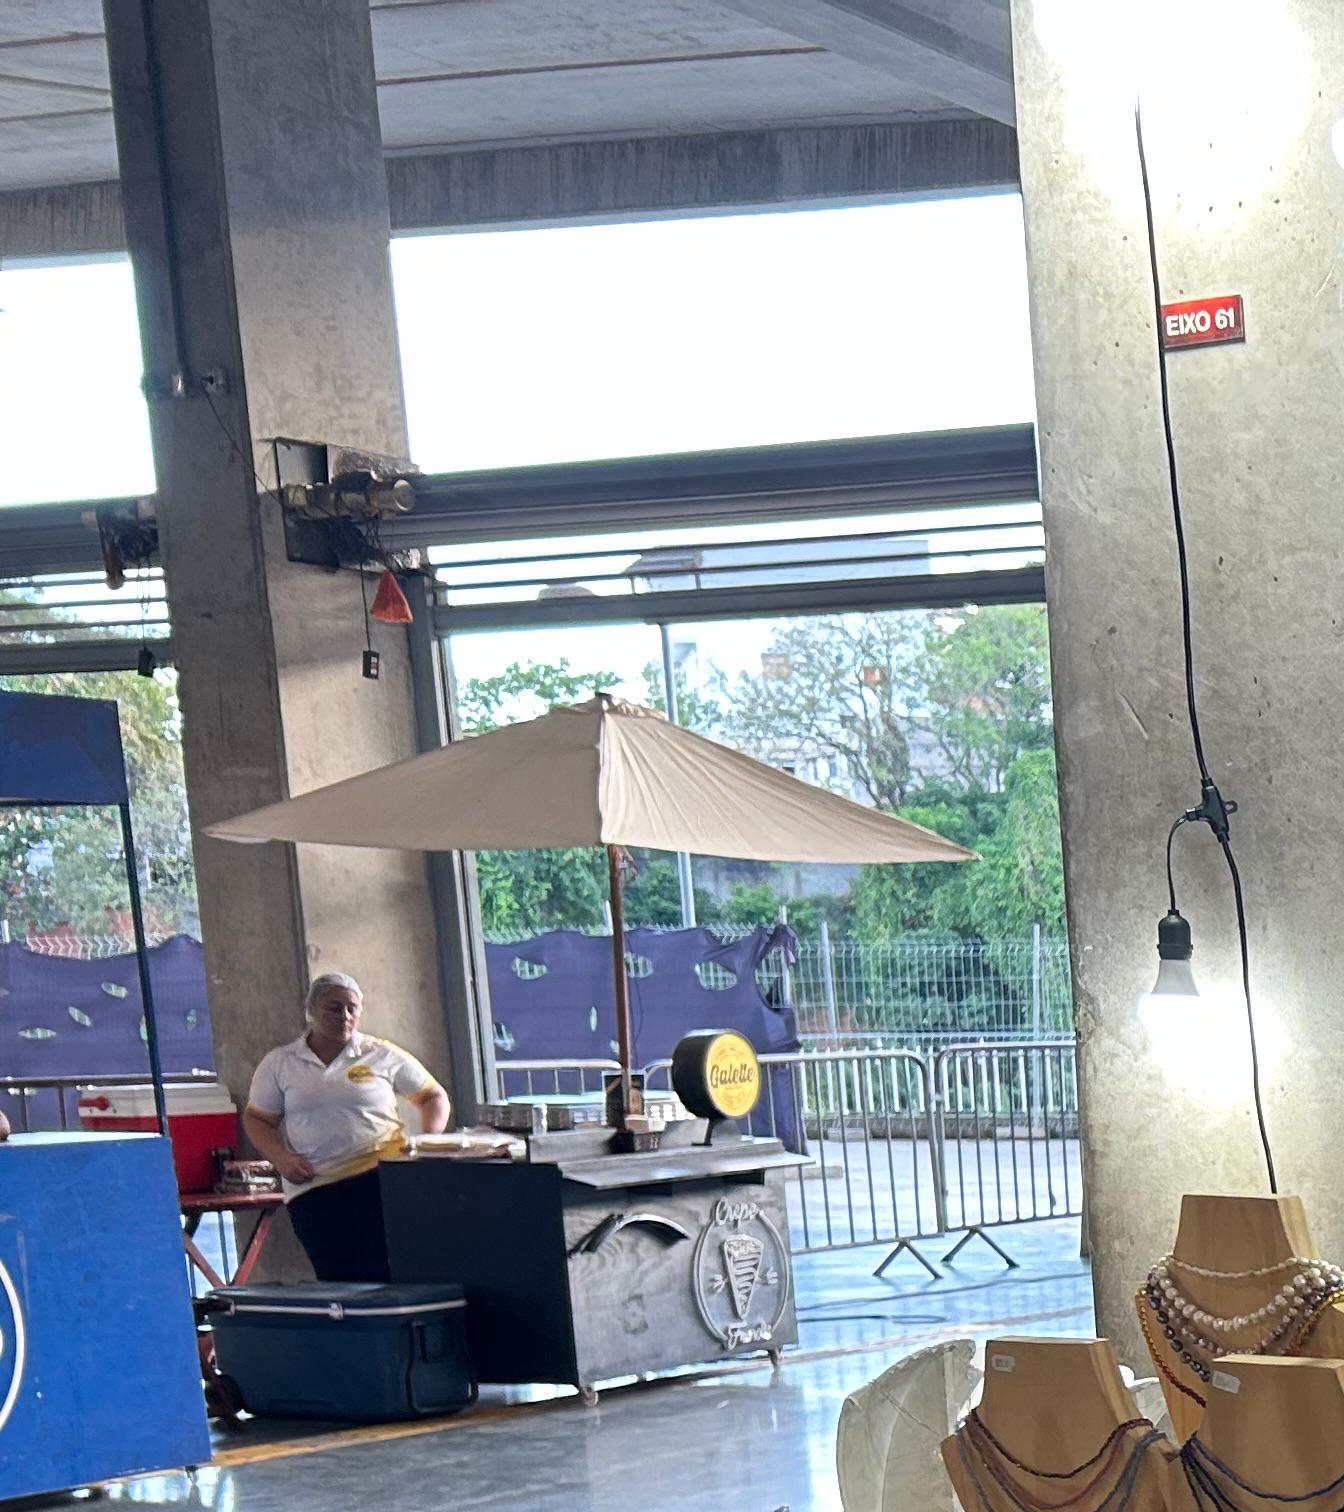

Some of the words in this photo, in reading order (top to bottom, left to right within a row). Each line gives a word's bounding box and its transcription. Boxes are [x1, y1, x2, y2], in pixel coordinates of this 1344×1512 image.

[1165, 310, 1211, 337] EIXO
[1214, 308, 1236, 330] 61
[709, 1061, 755, 1089] Galette
